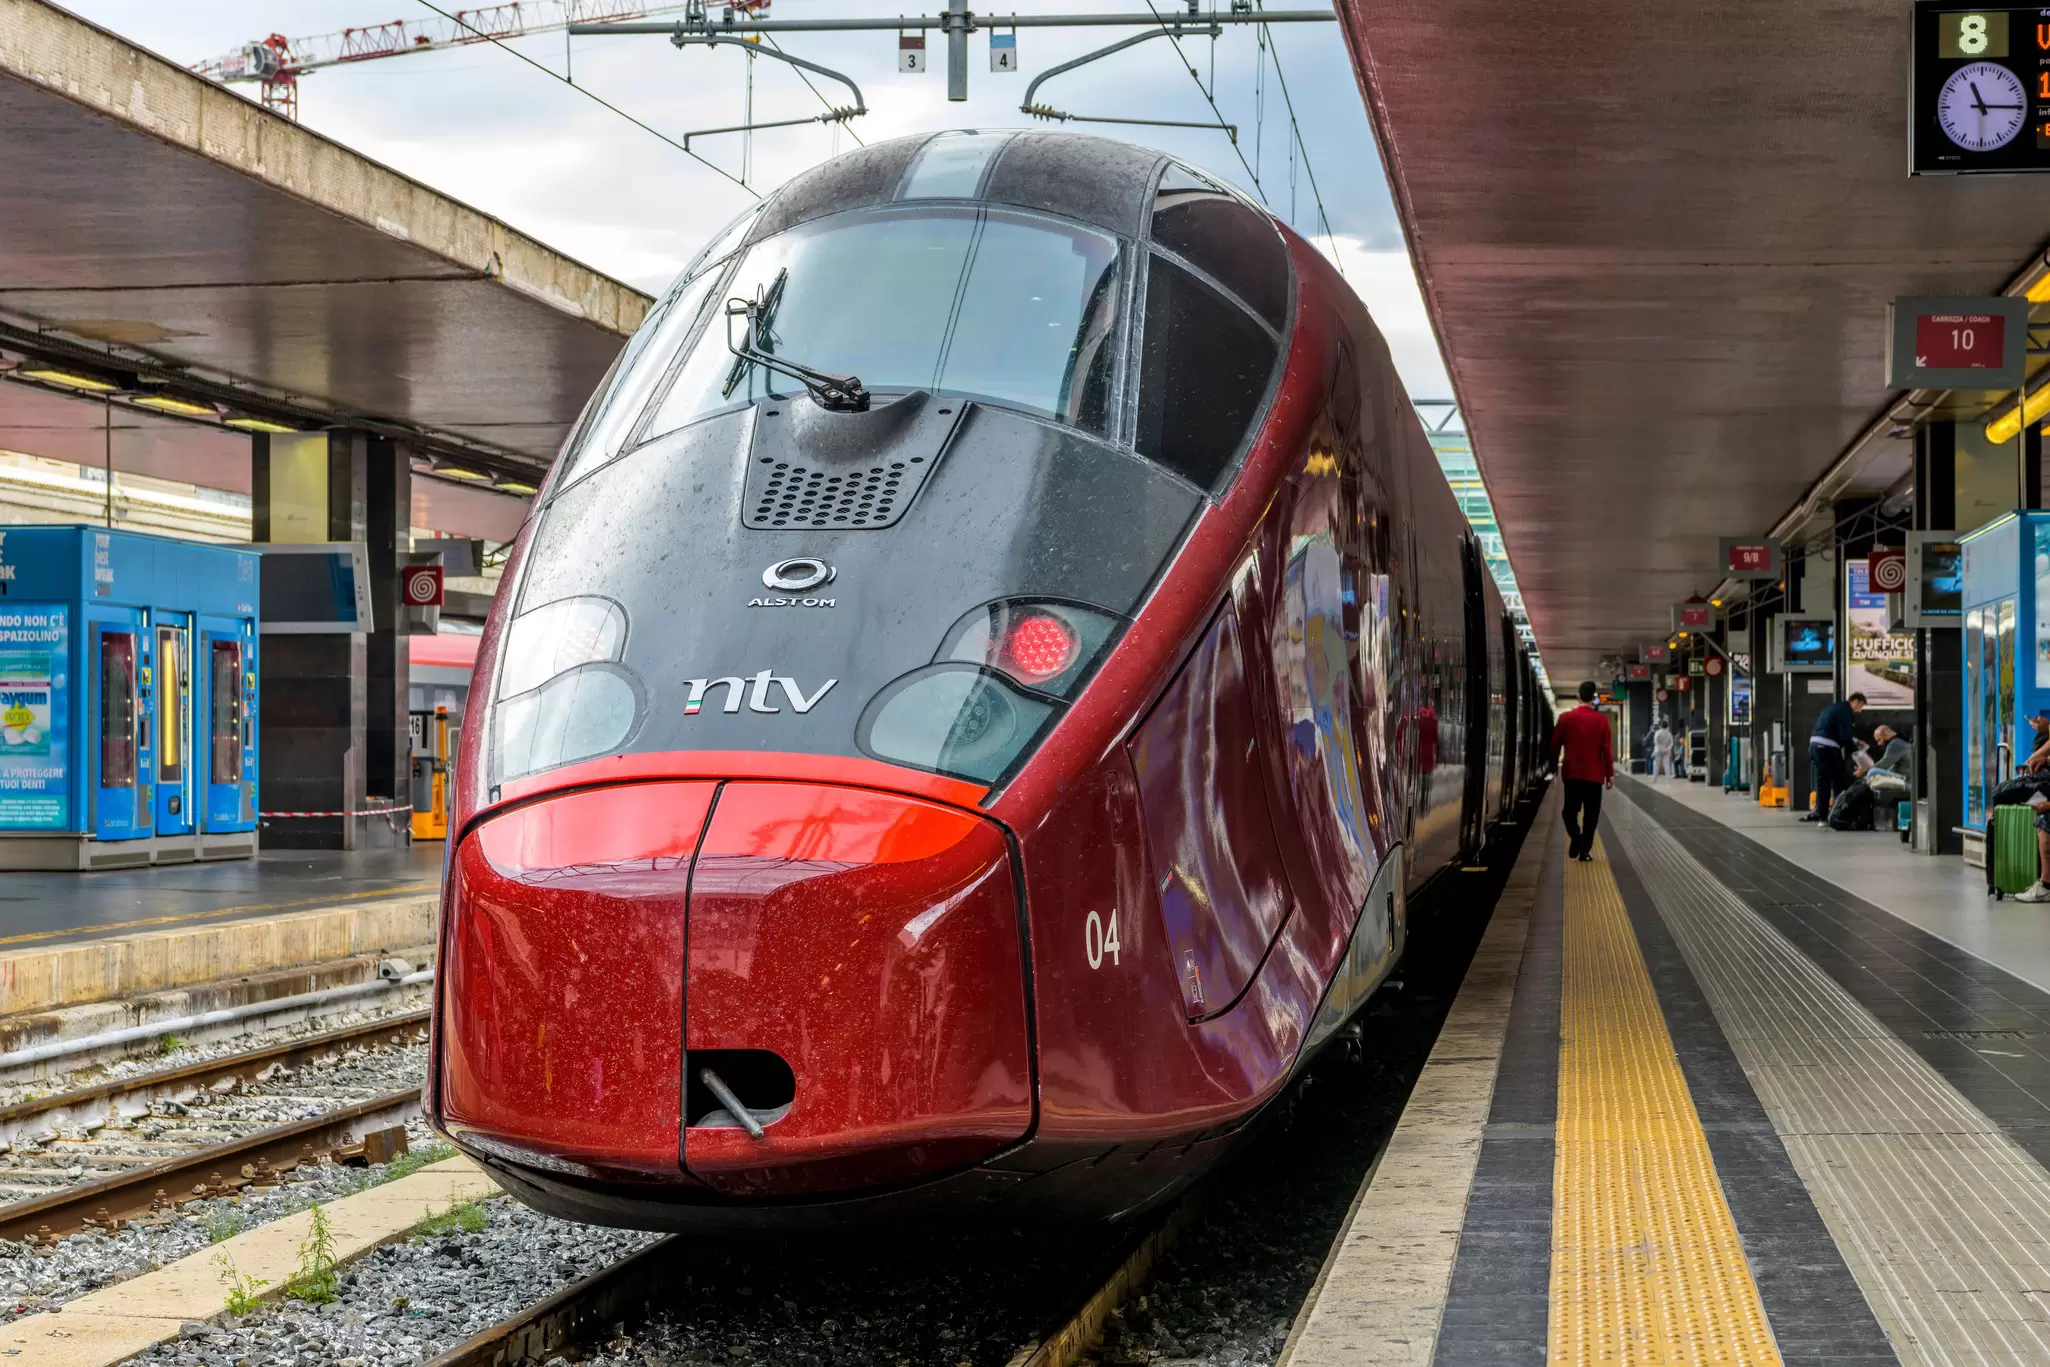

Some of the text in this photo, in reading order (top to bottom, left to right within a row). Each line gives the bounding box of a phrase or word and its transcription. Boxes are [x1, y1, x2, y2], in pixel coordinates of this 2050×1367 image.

[1959, 15, 1988, 54] 8
[908, 54, 916, 69] 3
[999, 53, 1008, 68] 4
[2039, 71, 2050, 98] 1
[1931, 315, 1964, 323] CARROZZA
[1969, 315, 1991, 323] COACH
[1951, 329, 1974, 350] 10
[1743, 551, 1759, 563] 9/8
[748, 597, 836, 608] ALSTOM
[24, 615, 48, 627] NON
[50, 612, 65, 626] C'È
[0, 629, 60, 642] SPAZZOLINO
[683, 669, 839, 715] ntv
[0, 692, 47, 709] aygum
[411, 717, 420, 735] 16
[3, 768, 64, 779] A PROTEGGERE
[0, 779, 46, 790] TUOI DENTI
[1085, 908, 1121, 970] 04
